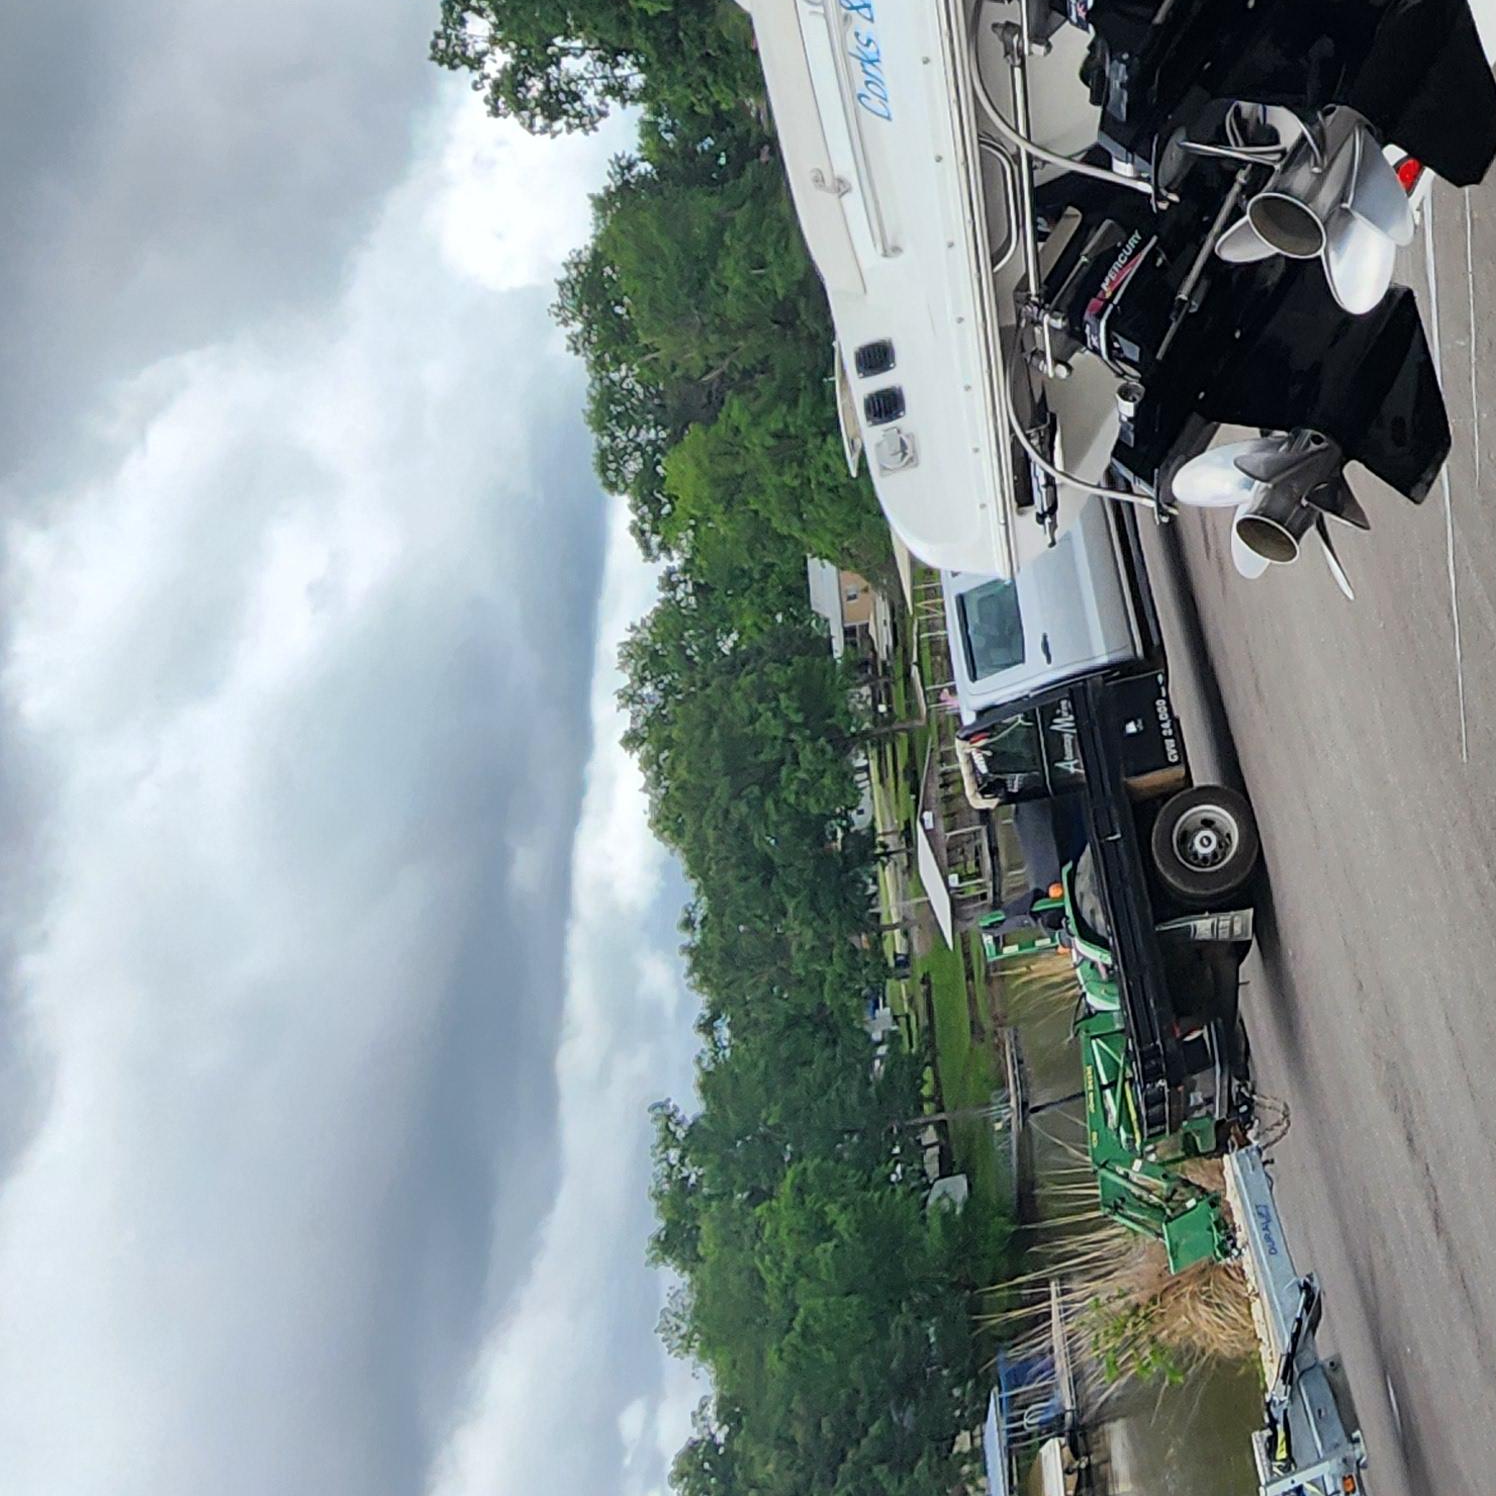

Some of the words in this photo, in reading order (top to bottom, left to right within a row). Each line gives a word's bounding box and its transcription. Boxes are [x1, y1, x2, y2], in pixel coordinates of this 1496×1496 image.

[849, 32, 892, 121] Corks
[1101, 229, 1142, 292] MERCURY
[1155, 699, 1173, 736] 24,000
